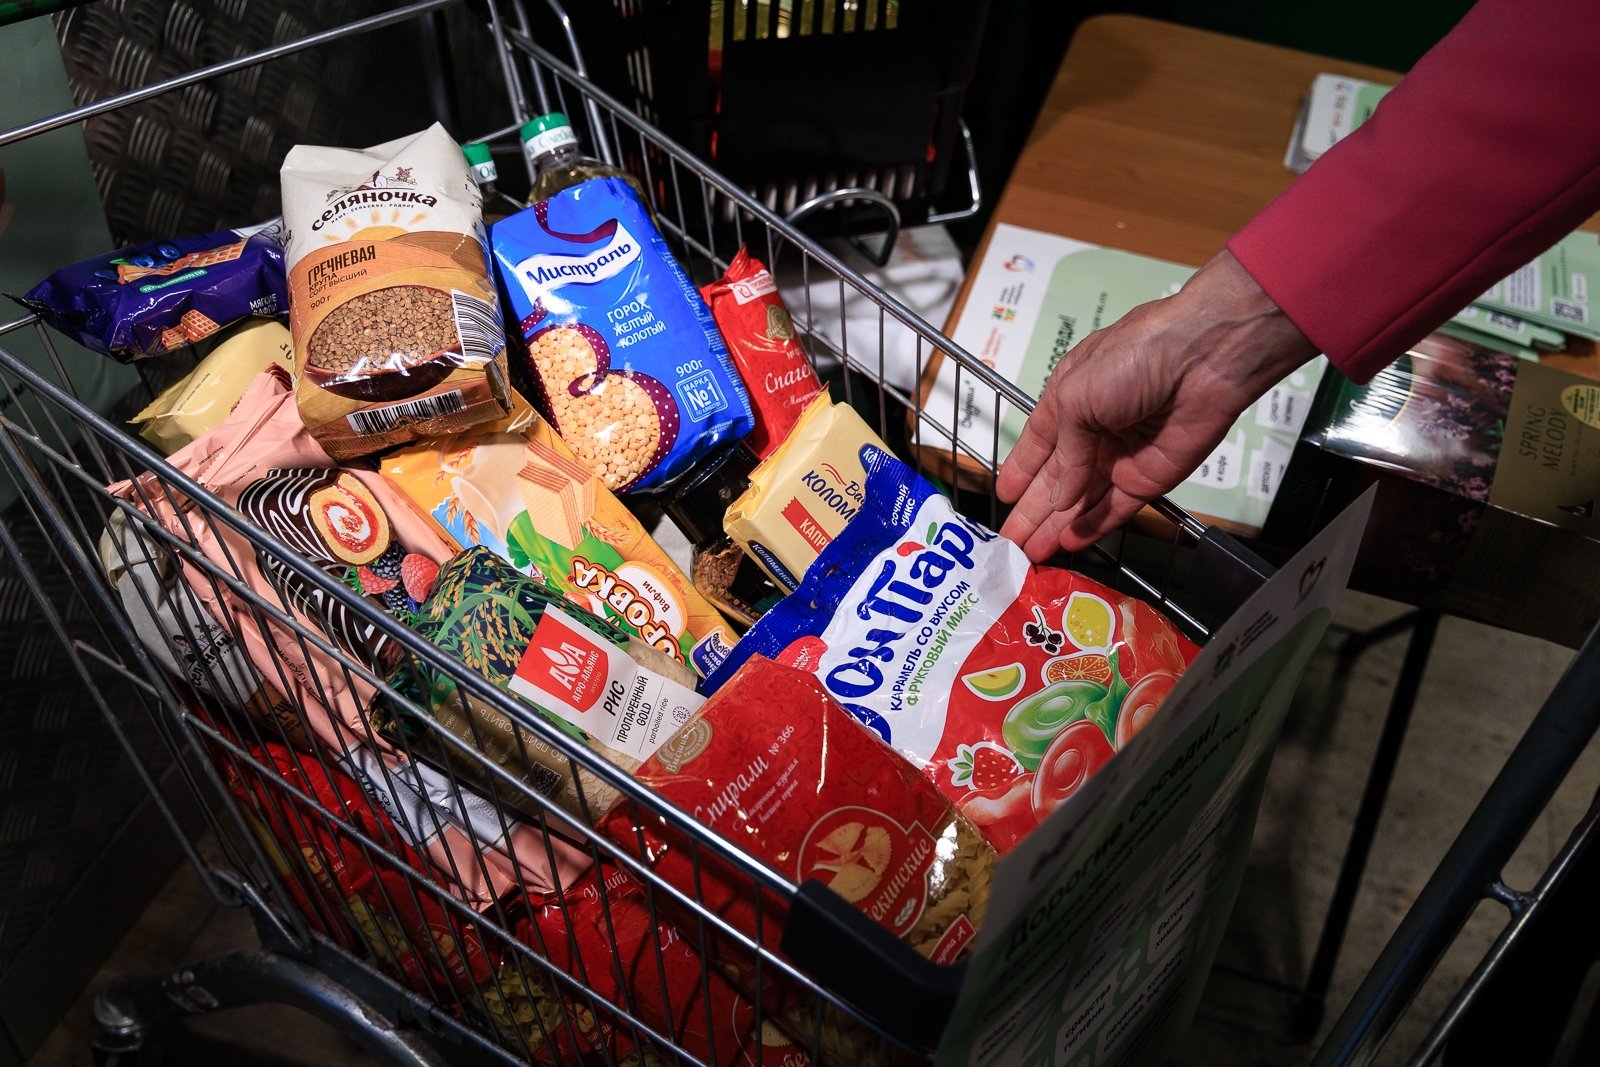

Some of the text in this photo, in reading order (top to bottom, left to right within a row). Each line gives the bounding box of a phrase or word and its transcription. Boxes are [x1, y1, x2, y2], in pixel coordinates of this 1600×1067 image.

[308, 245, 376, 286] ГРЕЧНЕВАЯ
[309, 273, 338, 293] КРУПА
[309, 268, 367, 298] СОРТ ВЫСШИЙ
[526, 241, 631, 286] Мистраль
[249, 293, 277, 310] МЯГКИЕ
[310, 296, 326, 311] 900
[606, 298, 652, 323] ГОРОХ
[613, 310, 655, 337] ЖЕЛТЫЙ
[618, 320, 667, 349] КОЛОТЫЙ
[683, 376, 710, 392] МАРКА
[1519, 404, 1546, 460] SPRING
[1542, 407, 1568, 472] MELODY
[891, 483, 909, 527] СОЧНЫЙ
[900, 497, 916, 528] МИКС
[642, 580, 671, 614] Вафли
[889, 580, 971, 712] КАРАМЕЛЬ СО ВКУСОМ
[906, 593, 981, 707] ФРУКТОВЫЙ МИКС
[571, 650, 599, 704] АГРО-АЛЬЯНС
[590, 671, 602, 694] экстра
[602, 680, 625, 717] РИС
[616, 675, 649, 743] ПРОПАРЕННЫЙ
[636, 702, 652, 727] GOLD
[649, 697, 669, 745] parboiled rice
[777, 724, 795, 744] 366
[1006, 820, 1125, 962] Дорогие
[1127, 711, 1221, 824] соседи!
[863, 838, 931, 921] екинские
[1157, 890, 1196, 935] бытовая
[1063, 1003, 1106, 1054] гигиены
[1065, 983, 1112, 1040] средства
